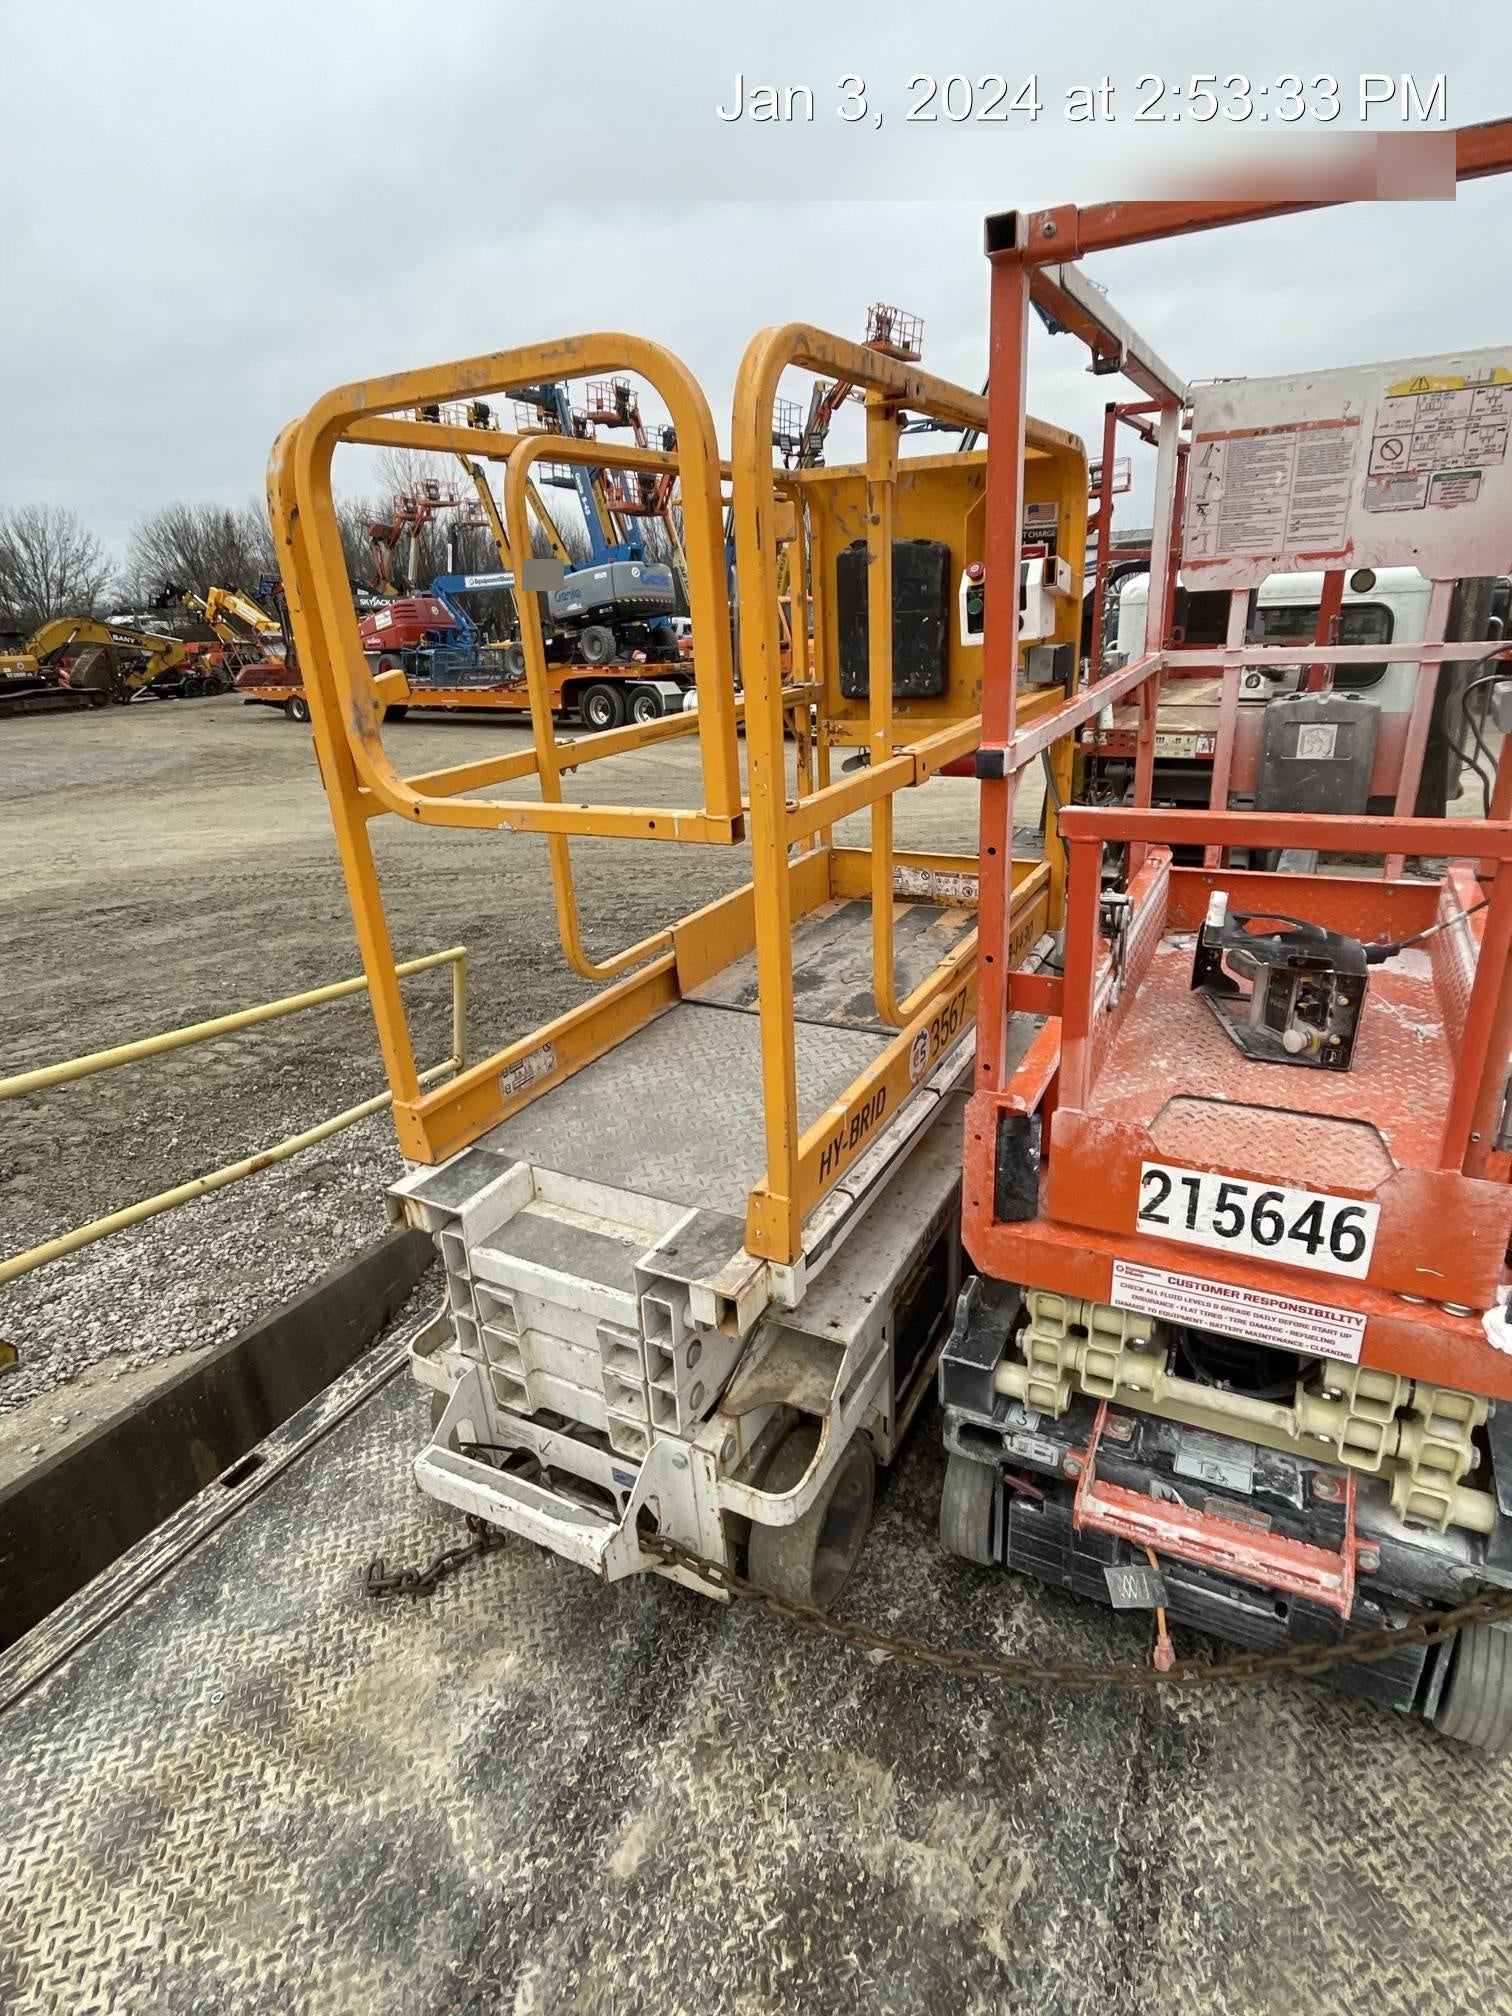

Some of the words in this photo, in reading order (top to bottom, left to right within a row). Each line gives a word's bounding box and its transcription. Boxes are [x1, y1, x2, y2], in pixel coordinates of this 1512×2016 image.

[1027, 530, 1056, 538] CHARGE
[112, 634, 136, 644] SANY
[930, 986, 968, 1057] 3567
[818, 1086, 886, 1185] HY-BRID
[1138, 1169, 1368, 1263] 215646
[1115, 1298, 1145, 1310] DAMAGE
[1146, 1305, 1157, 1313] TO
[1158, 1308, 1202, 1324] EQUIPMENT
[1209, 1320, 1243, 1334] BATTERY
[1244, 1328, 1303, 1348] MAINTENANCE
[1309, 1344, 1352, 1359] CLEANING
[1119, 1281, 1144, 1292] CHECK
[1145, 1287, 1158, 1295] ALL
[1159, 1290, 1182, 1301] FLUID
[1184, 1296, 1211, 1308] LEVELS
[1220, 1304, 1250, 1317] GREASE
[1252, 1312, 1276, 1322] DAILY
[1277, 1317, 1309, 1330] BEFORE
[1311, 1325, 1338, 1336] START
[1339, 1331, 1352, 1340] UP
[1131, 1293, 1174, 1308] INSURANCE
[1180, 1304, 1197, 1314] FLAT
[1198, 1309, 1222, 1319] TIRES
[1228, 1316, 1247, 1325] TIRE
[1249, 1320, 1283, 1333] DAMAGE
[1289, 1329, 1335, 1346] REFUELING
[1167, 1276, 1240, 1299] CUSTOMER
[1243, 1292, 1363, 1326] RESPONSIBILITY
